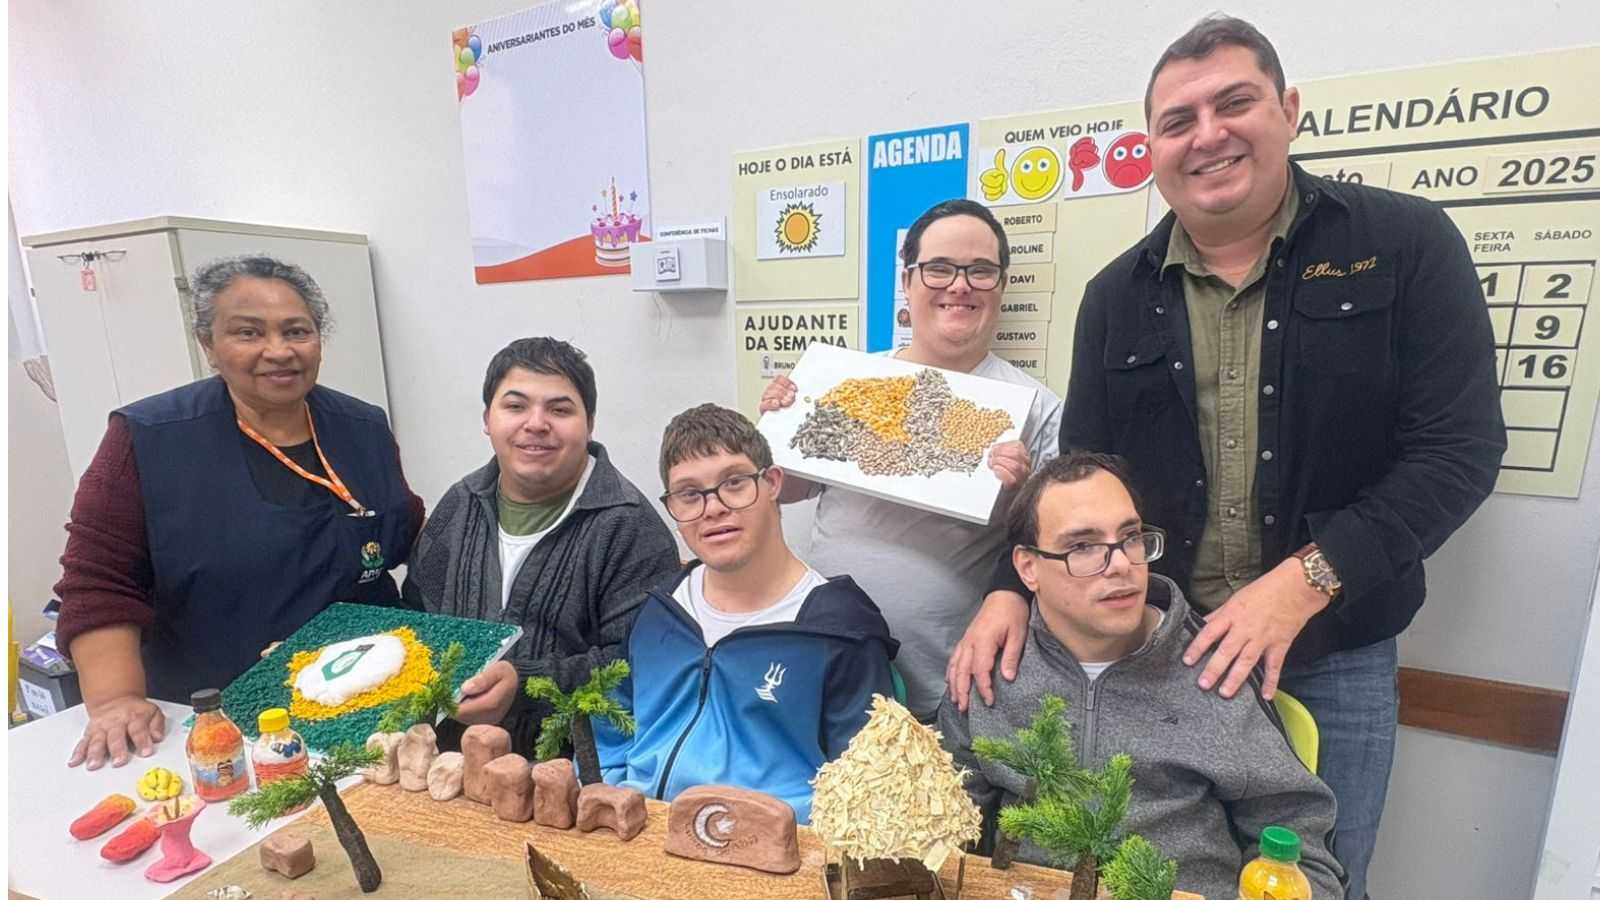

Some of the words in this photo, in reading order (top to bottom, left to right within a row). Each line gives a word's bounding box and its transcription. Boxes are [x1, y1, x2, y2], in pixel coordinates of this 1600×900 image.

[487, 26, 561, 54] ANIVERSARIANTES
[562, 22, 576, 34] DO
[1295, 85, 1550, 138] ALENDÁRIO
[1004, 128, 1045, 144] QUEM
[1049, 124, 1082, 139] VEIO
[873, 130, 963, 169] AGENDA
[738, 158, 771, 176] HOJE
[775, 158, 787, 171] O
[791, 155, 814, 170] DIA
[819, 146, 853, 167] ESTÁ
[1411, 165, 1479, 190] ANO
[1497, 155, 1596, 187] 2025
[770, 184, 829, 201] Ensolarado
[1004, 214, 1043, 226] ROBERTO
[1473, 231, 1515, 241] SEXTA
[1534, 229, 1592, 241] SÁBADO
[1009, 244, 1044, 255] ROLINE
[1473, 243, 1512, 253] FEIRA
[1010, 274, 1035, 284] DAVI
[1302, 261, 1346, 280] Ellus
[1480, 272, 1498, 297] 1
[1543, 273, 1572, 299] 2
[1000, 303, 1038, 313] GABRIEL
[744, 314, 848, 331] AJUDANTE
[1534, 315, 1561, 340] 9
[745, 336, 769, 351] DA
[996, 331, 1036, 341] GUSTAVO
[774, 361, 796, 370] BRUNO
[1009, 360, 1038, 369] RIQUE
[1518, 354, 1568, 379] 16
